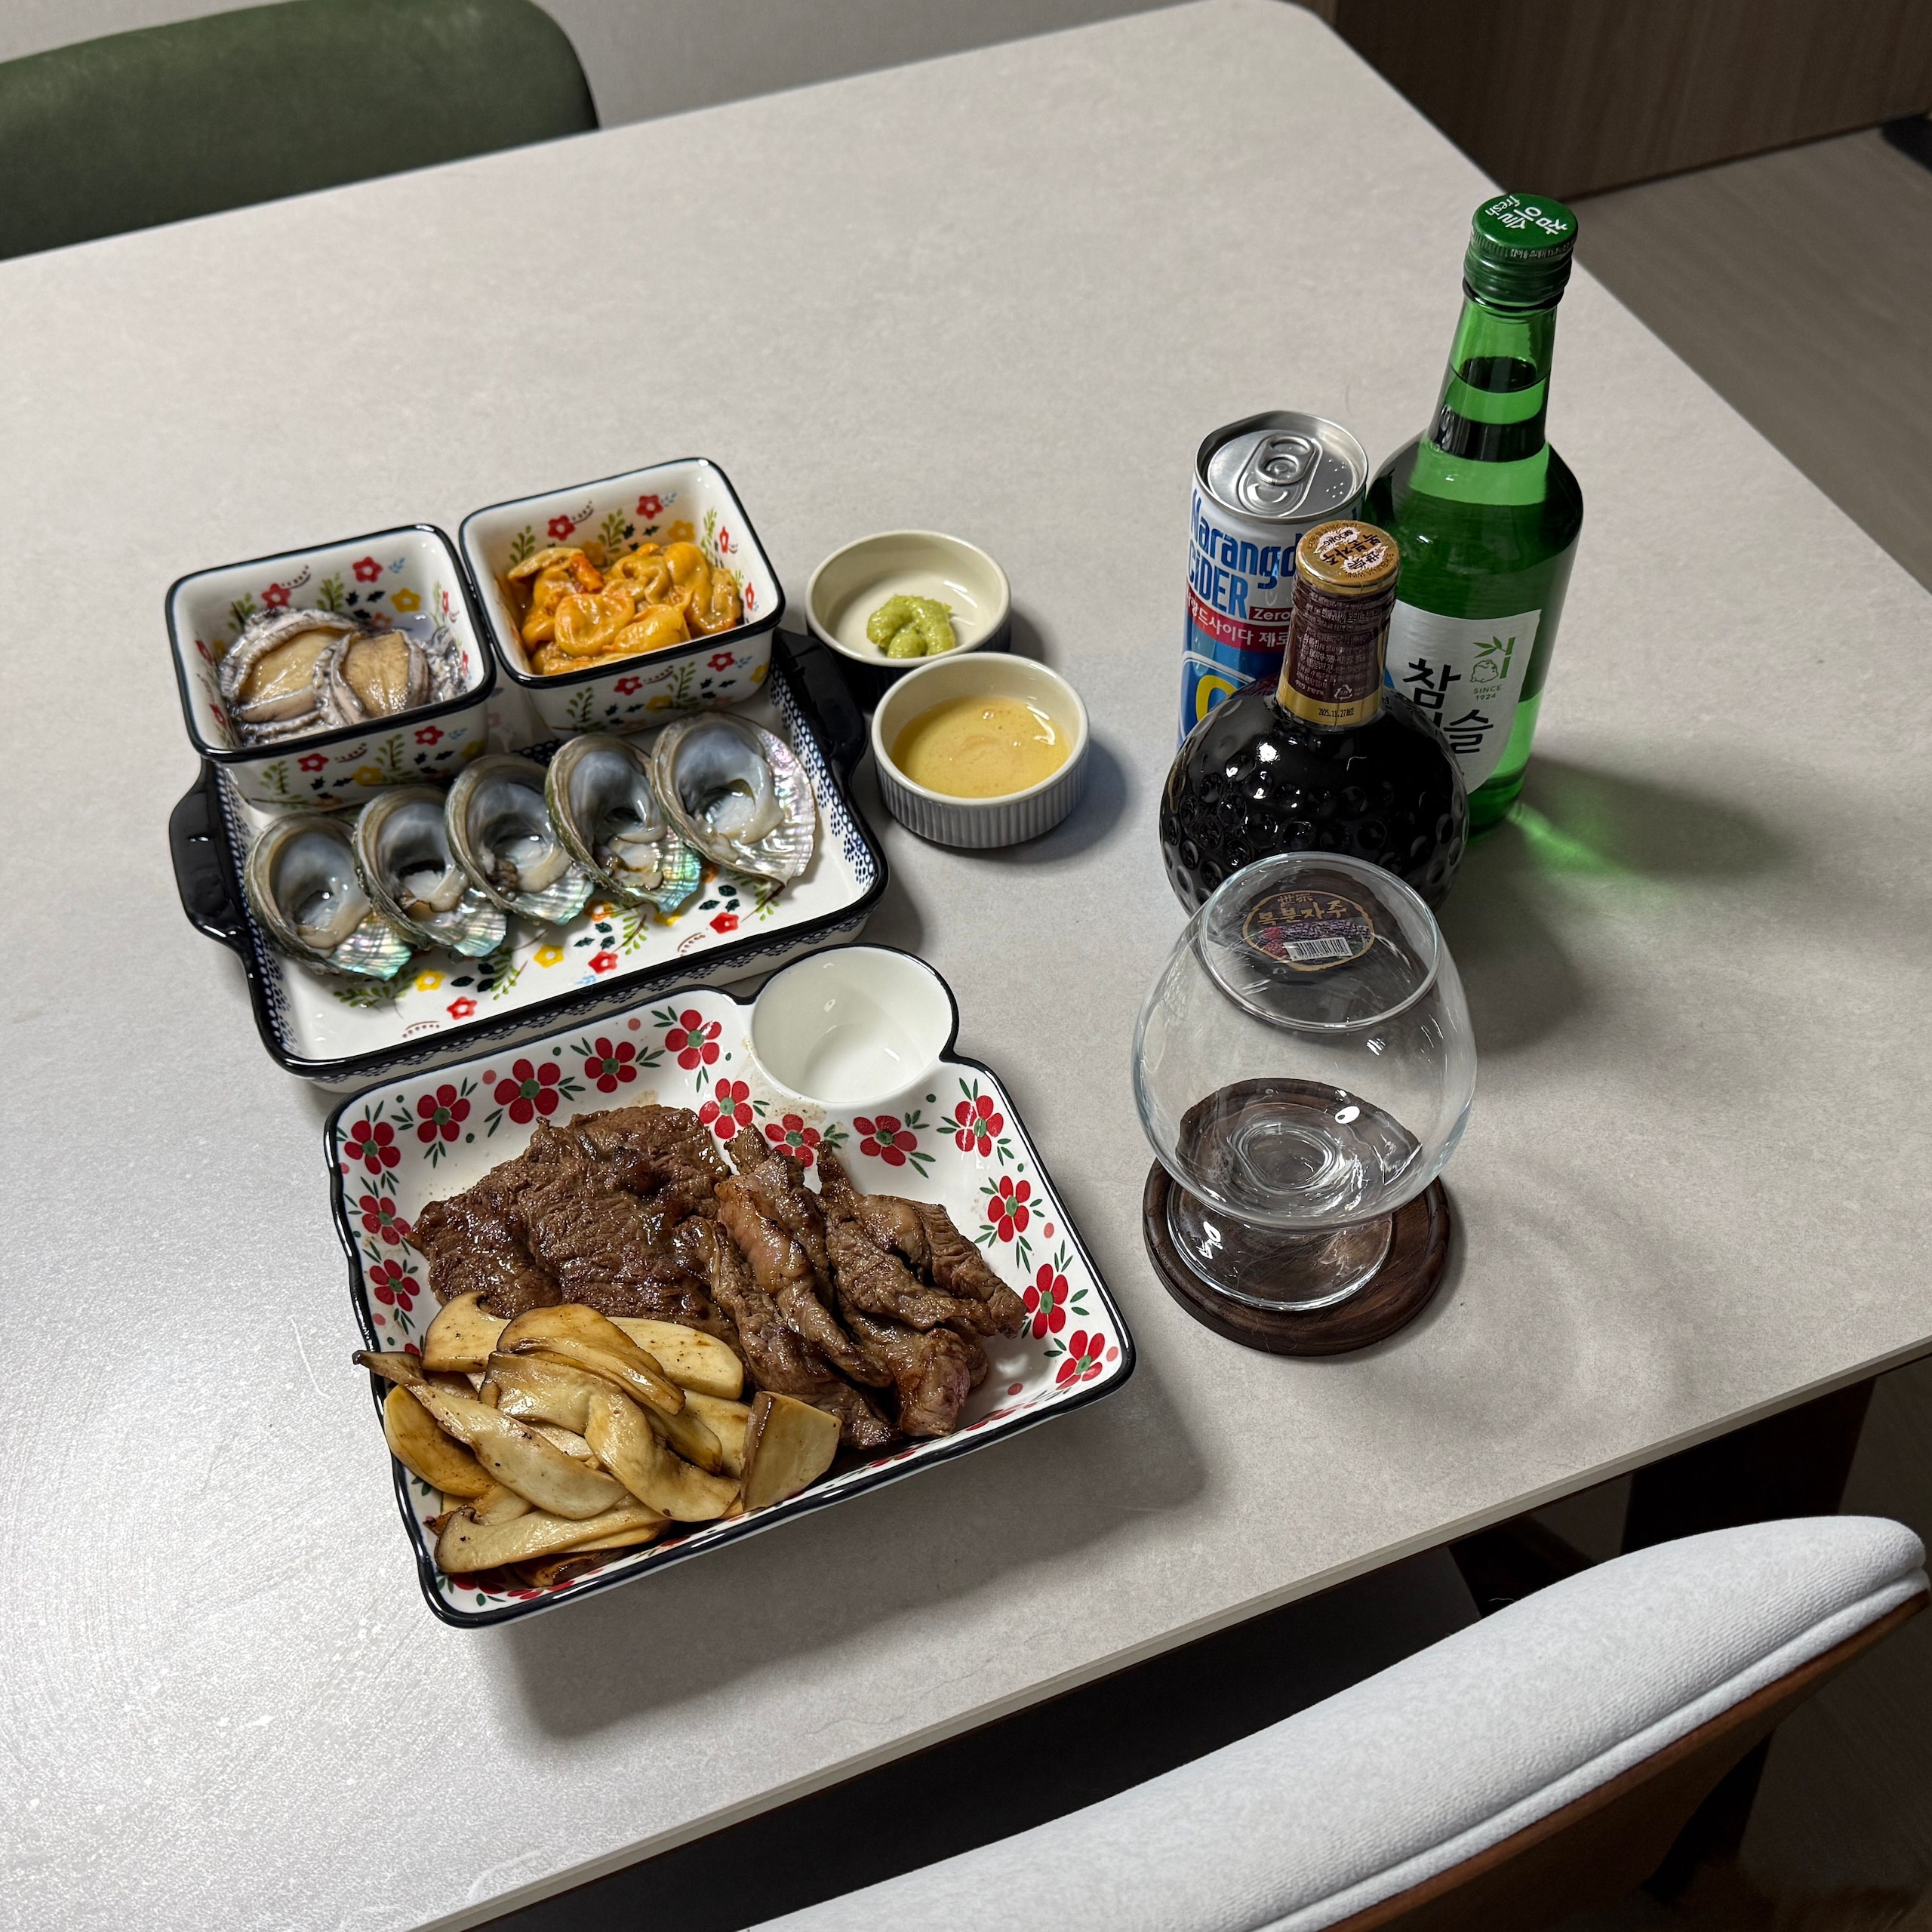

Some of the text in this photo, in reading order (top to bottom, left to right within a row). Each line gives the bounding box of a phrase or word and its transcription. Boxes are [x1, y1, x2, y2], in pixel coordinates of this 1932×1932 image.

[1485, 195, 1521, 216] fresh
[1497, 207, 1567, 235] 참이슬
[1321, 534, 1382, 565] 복분자주
[1324, 530, 1354, 546] SEJONG
[1253, 608, 1291, 620] Zero
[1473, 685, 1502, 694] SINCE
[1402, 657, 1494, 754] 참슬
[1257, 900, 1346, 925] 복분자주
